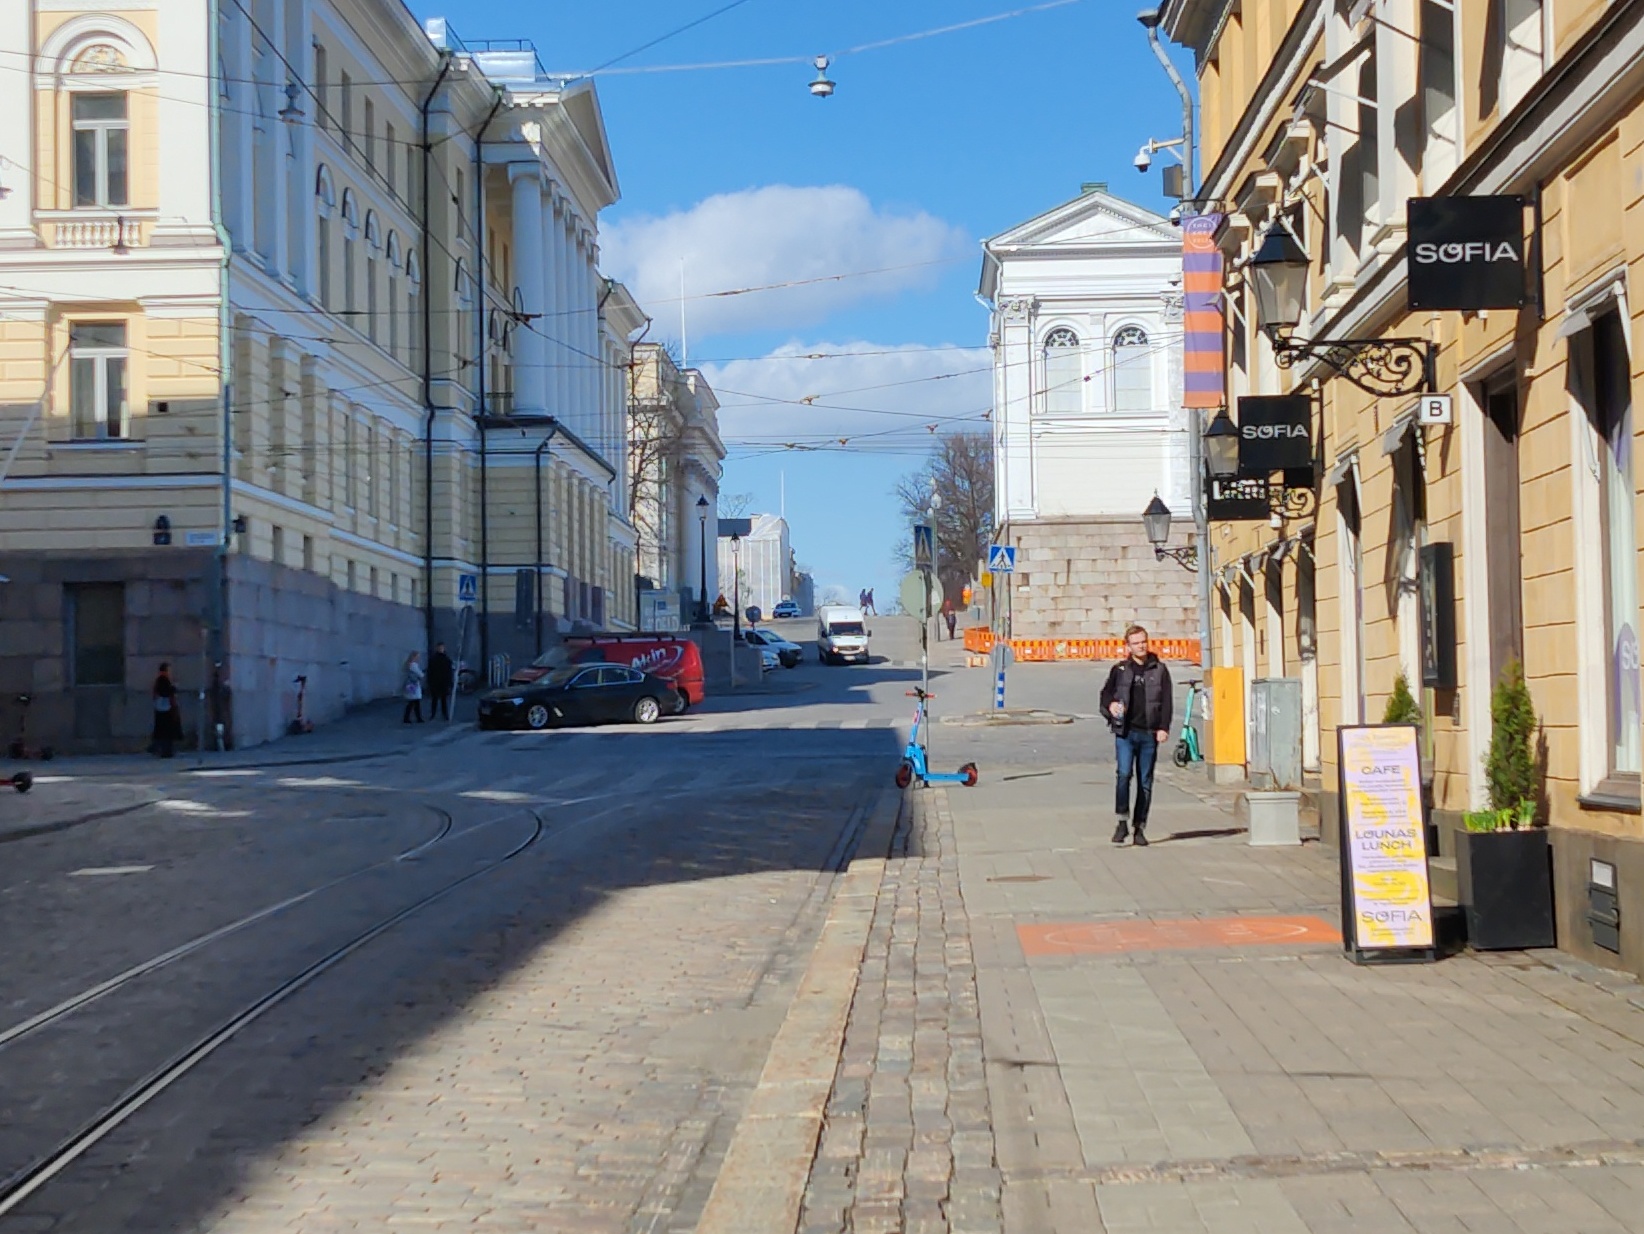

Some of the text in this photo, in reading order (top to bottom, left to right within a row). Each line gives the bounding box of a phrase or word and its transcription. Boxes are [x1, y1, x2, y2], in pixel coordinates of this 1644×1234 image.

[1415, 241, 1519, 263] SOFIA
[1430, 401, 1443, 416] B
[1355, 829, 1416, 839] LOUNAS
[1362, 840, 1412, 850] LUNCH
